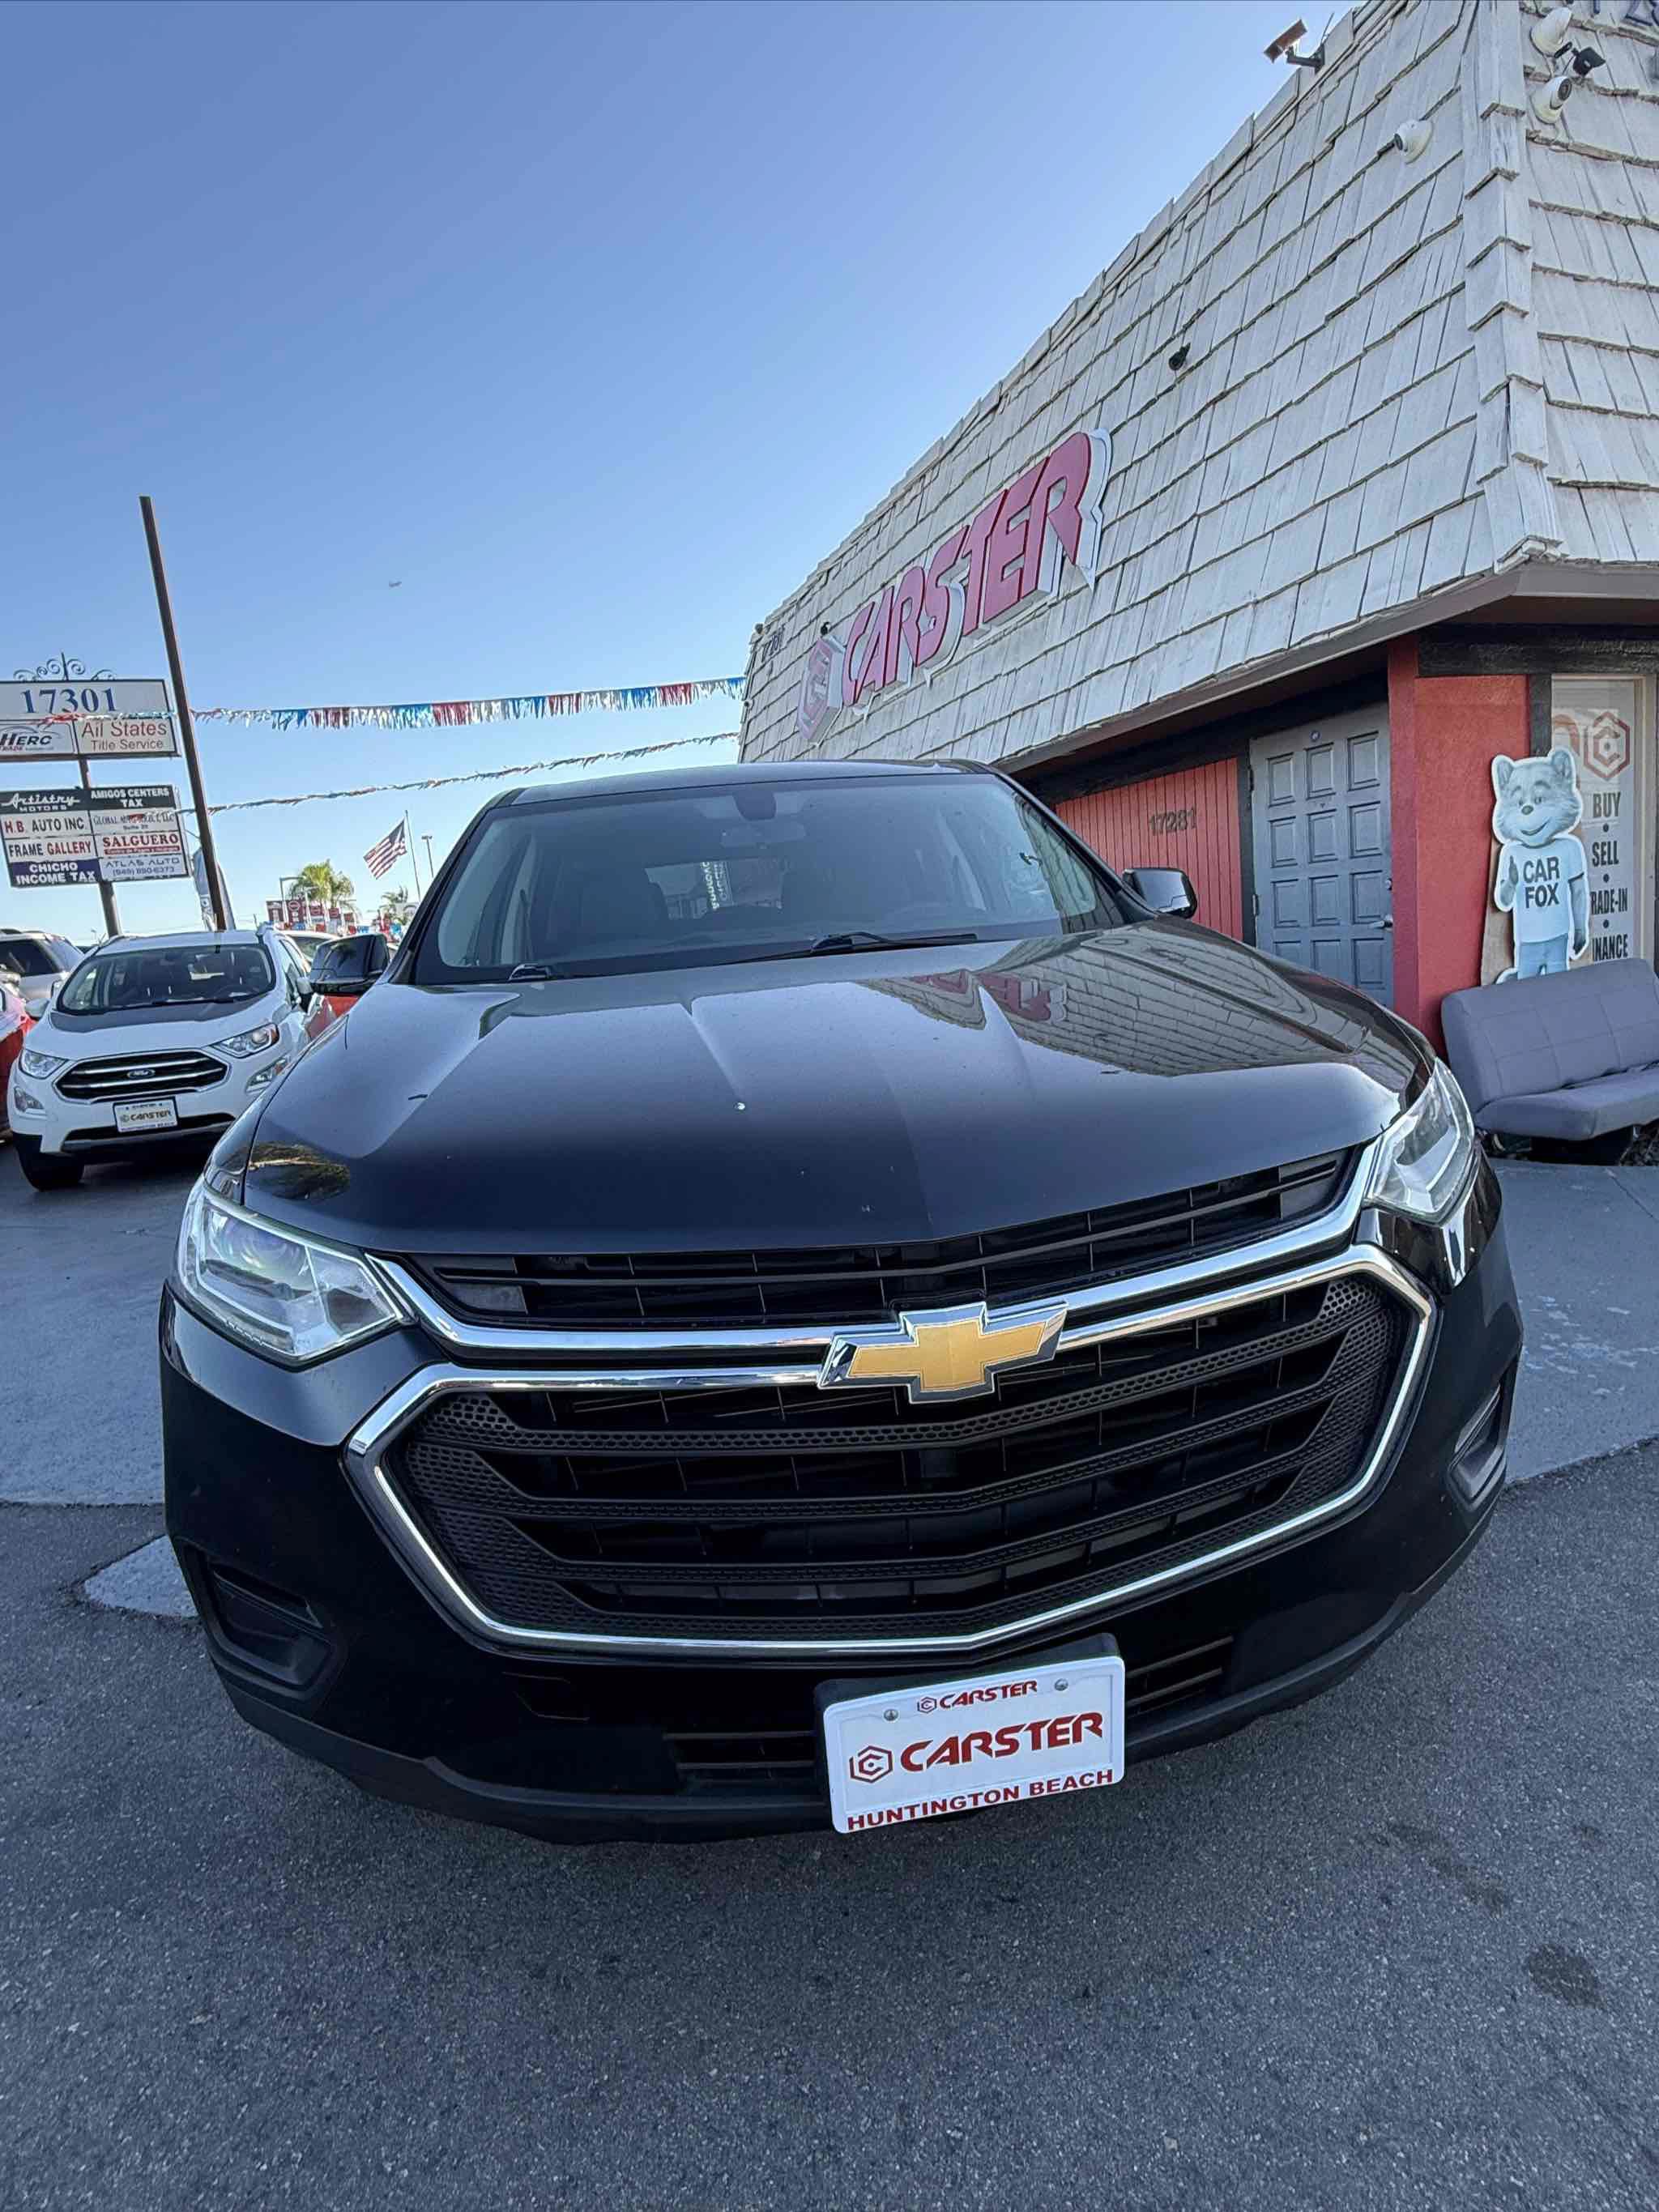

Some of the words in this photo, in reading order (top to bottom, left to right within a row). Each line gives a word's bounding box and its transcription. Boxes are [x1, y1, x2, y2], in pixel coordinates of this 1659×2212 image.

[842, 431, 1108, 708] CARSTER
[20, 688, 117, 714] 17301
[110, 720, 167, 737] States
[91, 739, 116, 751] Title
[121, 738, 163, 750] Service
[1, 793, 80, 808] Artistry
[91, 789, 126, 799] AMIGOS
[128, 787, 169, 797] CENTERS
[121, 799, 143, 808] TAX
[1593, 792, 1621, 818] BUY
[32, 818, 62, 832] AUTO
[65, 817, 84, 830] INC
[8, 844, 44, 858] FRAME
[47, 842, 92, 855] GALLERY
[103, 833, 179, 847] SALGUERO
[105, 859, 144, 867] ATLAS
[148, 857, 179, 866] AUTO
[1592, 841, 1619, 867] SELL
[16, 873, 66, 885] INCOME
[70, 871, 96, 882] TAX
[29, 863, 79, 873] CHICHO
[1523, 857, 1560, 883] CAR
[1525, 882, 1560, 908] FOX
[1590, 888, 1628, 914] RADE-IN
[1592, 934, 1628, 961] INANCE
[940, 1680, 1038, 1710] CARSTER
[901, 1712, 1103, 1772] CARSTER
[847, 1785, 1020, 1831] HUNTINGTON
[1030, 1769, 1113, 1796] BEACH
